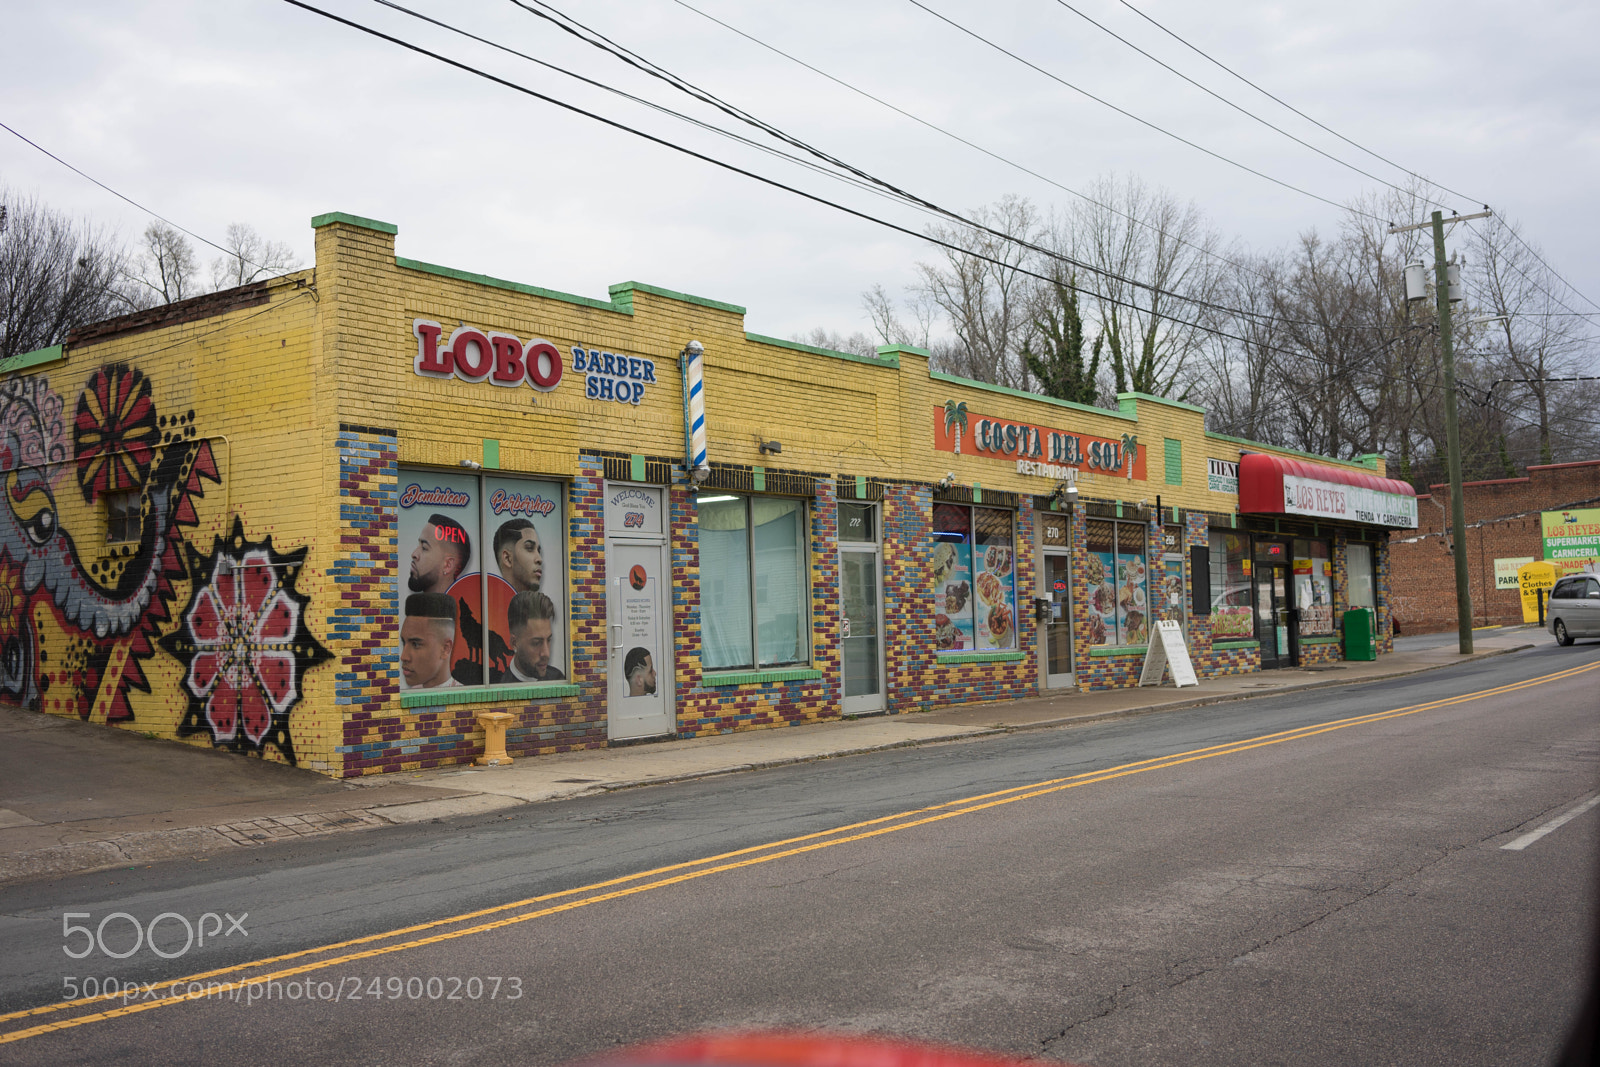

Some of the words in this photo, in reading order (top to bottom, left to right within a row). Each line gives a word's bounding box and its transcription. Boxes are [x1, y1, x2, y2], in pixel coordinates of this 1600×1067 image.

[417, 322, 564, 389] LOBO
[572, 347, 656, 383] BARBER
[586, 375, 645, 405] SHOP
[974, 419, 1042, 459] COSTA
[1047, 432, 1084, 466] DEL
[1087, 441, 1122, 472] SOL
[1016, 459, 1079, 482] RESTAURANT
[401, 484, 470, 508] Dominican
[490, 489, 556, 516] Barbershop
[610, 489, 655, 508] WELCOME
[1295, 484, 1314, 510] LOS
[1315, 488, 1346, 514] REYES
[624, 512, 644, 528] 274
[1355, 510, 1375, 522] TIENDA
[1377, 512, 1381, 522] Y
[1383, 513, 1412, 526] CARNICERIA
[434, 524, 467, 545] OPEN
[1047, 527, 1059, 538] 270
[1547, 525, 1565, 537] LOS
[1567, 523, 1600, 536] REYES
[1546, 536, 1600, 547] SUPERMARKET
[1552, 547, 1598, 558] CARNICERIA
[1053, 582, 1066, 590] OPEN
[1522, 580, 1553, 589] Clothes
